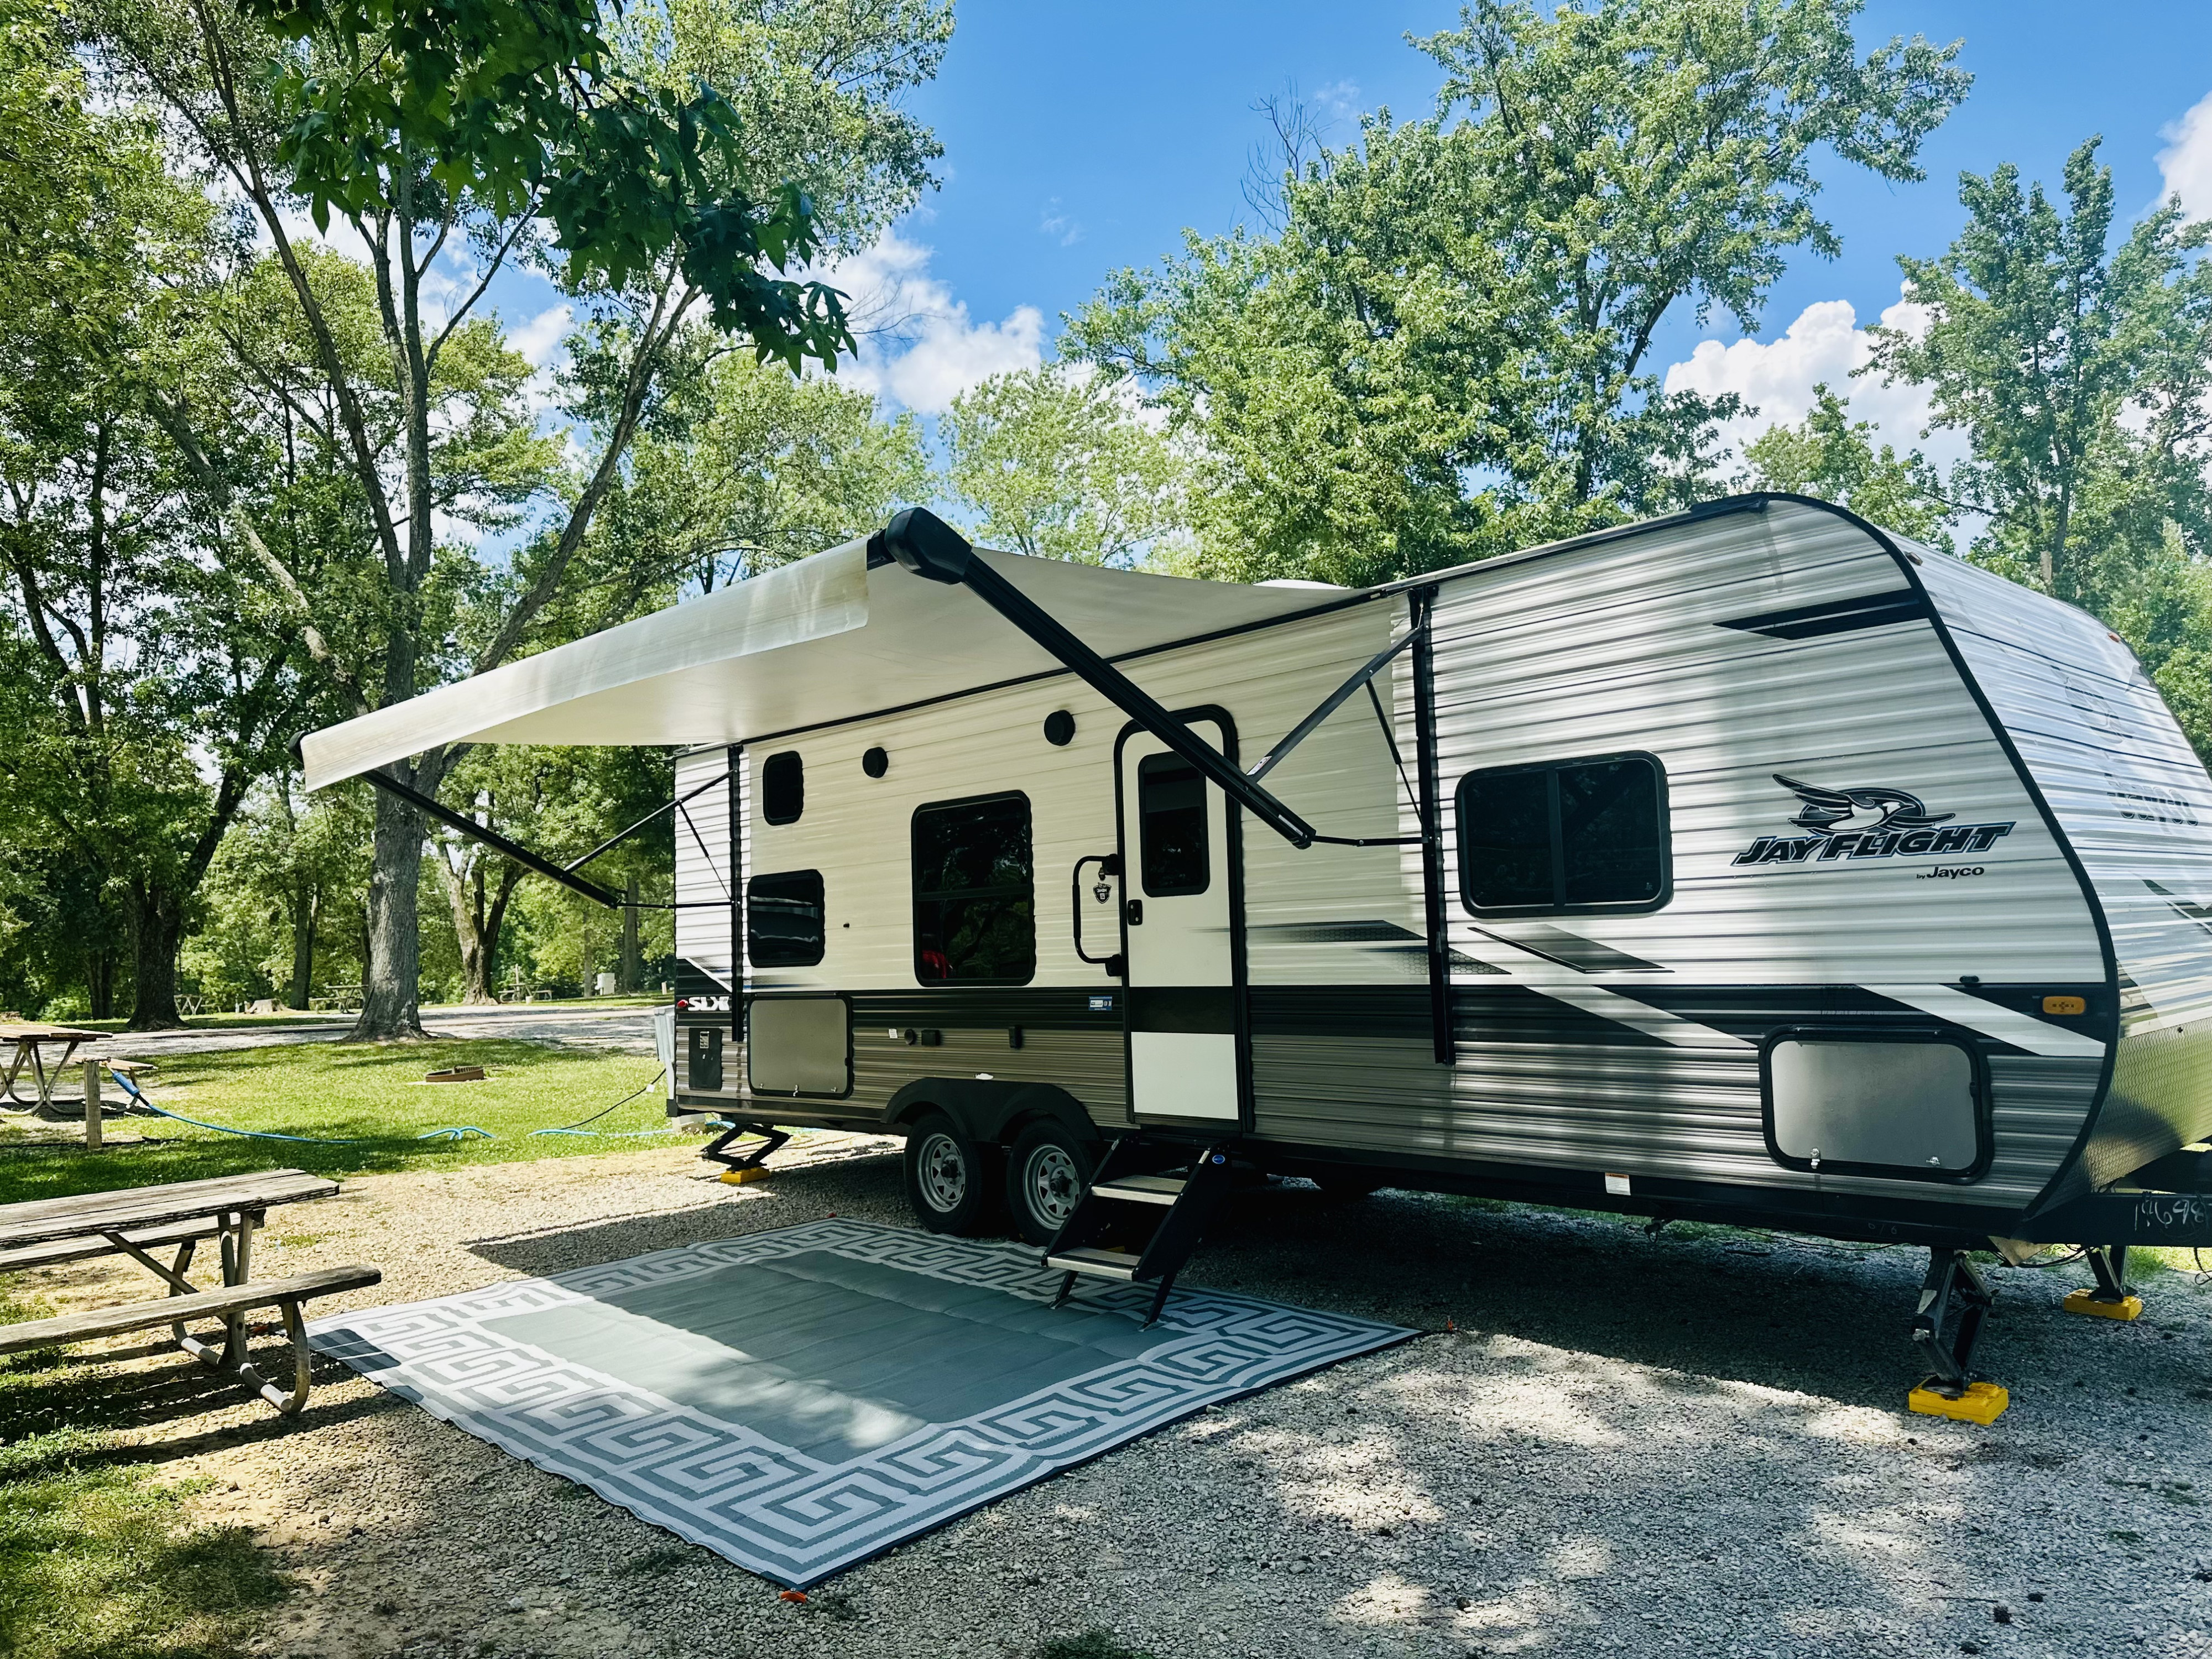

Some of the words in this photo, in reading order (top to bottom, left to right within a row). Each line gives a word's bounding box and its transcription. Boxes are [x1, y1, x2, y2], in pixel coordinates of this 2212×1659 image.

[1730, 836, 1829, 866] JAY
[1817, 821, 2017, 862] FLIGHT
[1926, 867, 1985, 879] Jayco
[688, 996, 729, 1011] SLX
